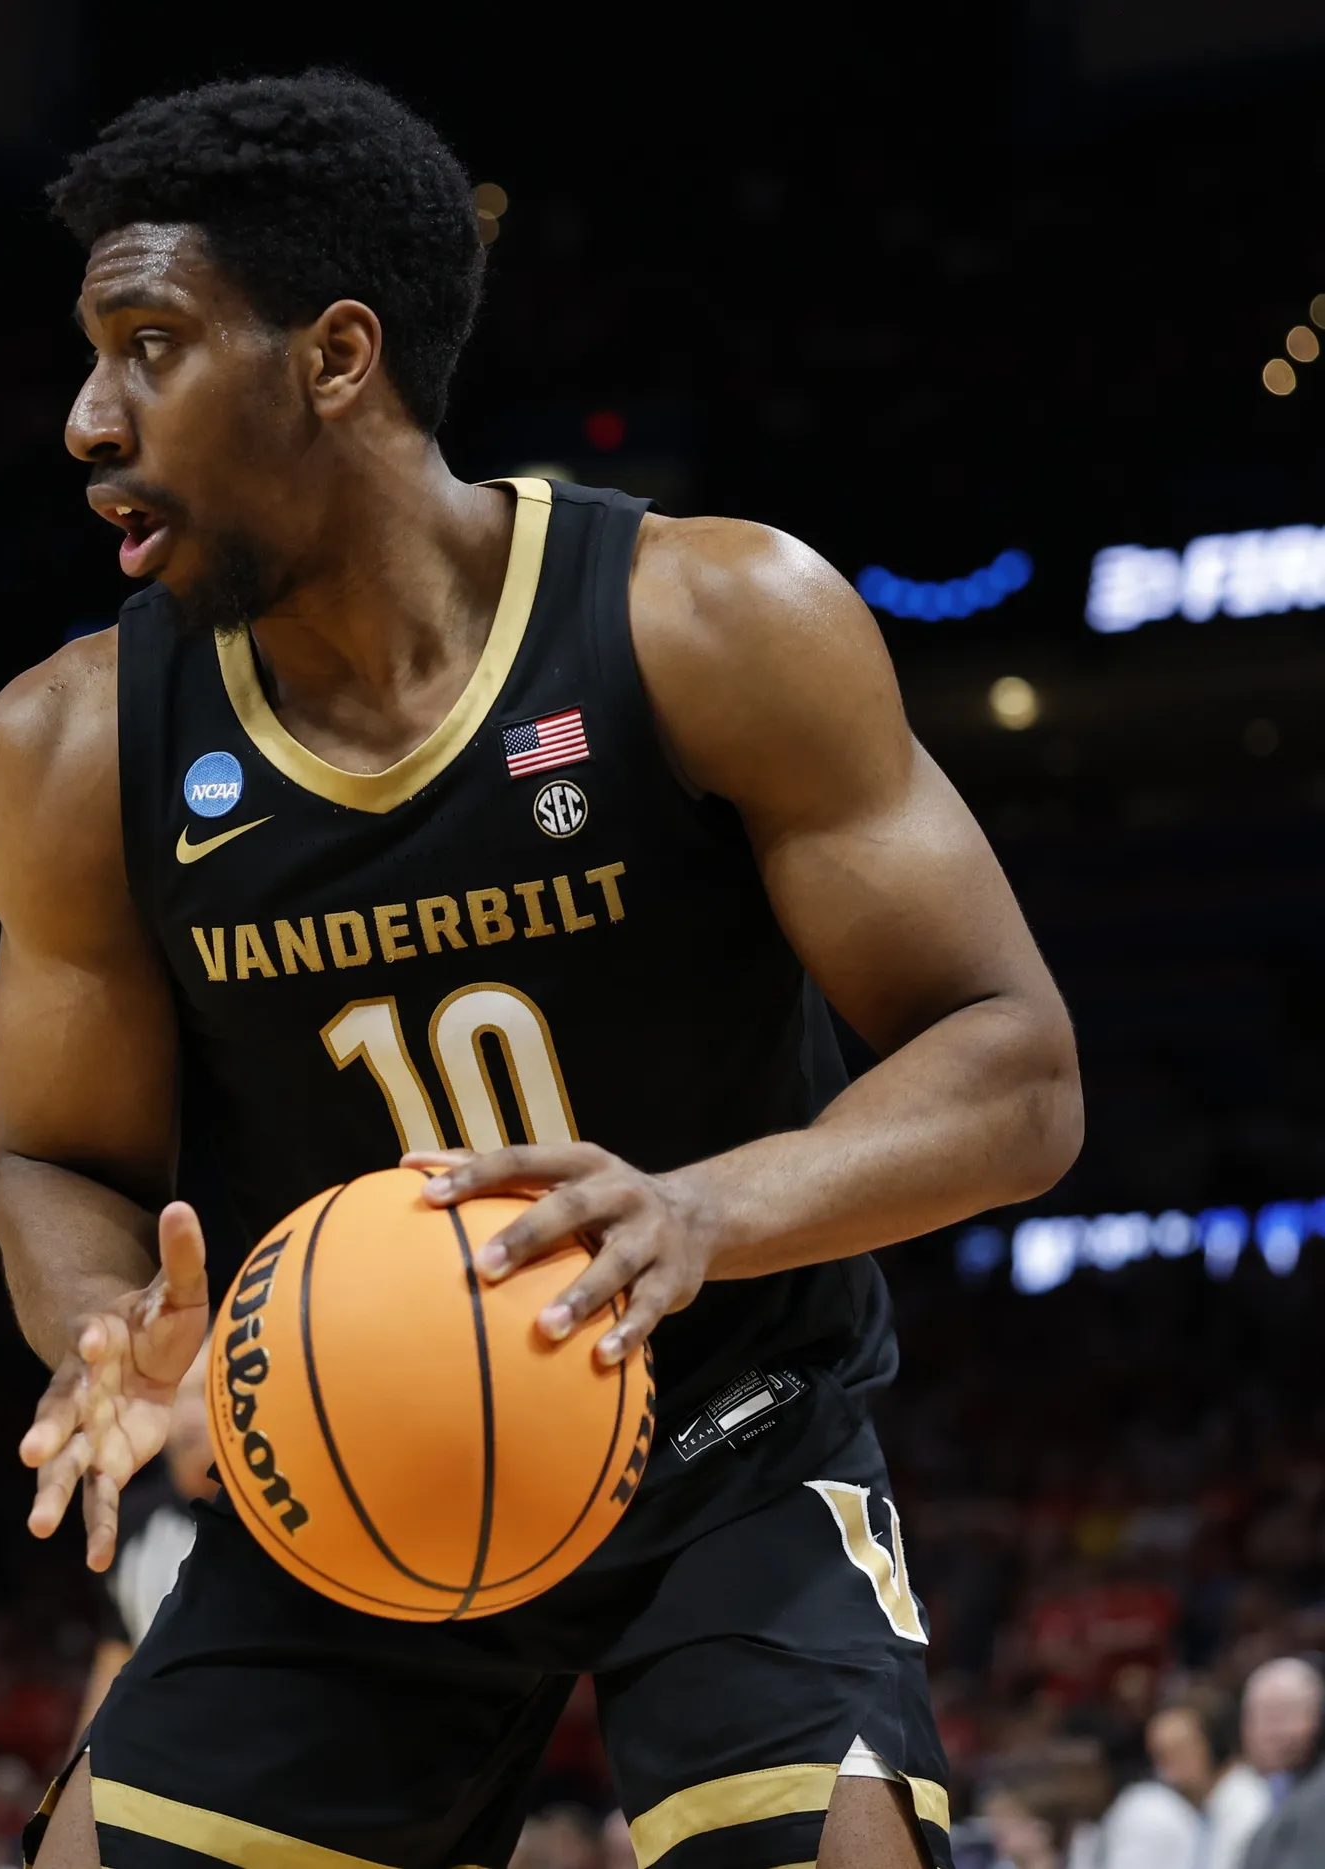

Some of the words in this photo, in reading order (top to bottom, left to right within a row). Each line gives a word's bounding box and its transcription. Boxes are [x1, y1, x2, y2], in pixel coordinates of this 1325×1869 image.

[191, 781, 241, 801] NCAA
[537, 785, 583, 834] SEC
[191, 861, 626, 982] VANDERBILT
[319, 981, 581, 1155] 10
[225, 1230, 310, 1538] Wilson
[682, 1428, 715, 1450] TEAM
[742, 1420, 776, 1441] 2023-2024
